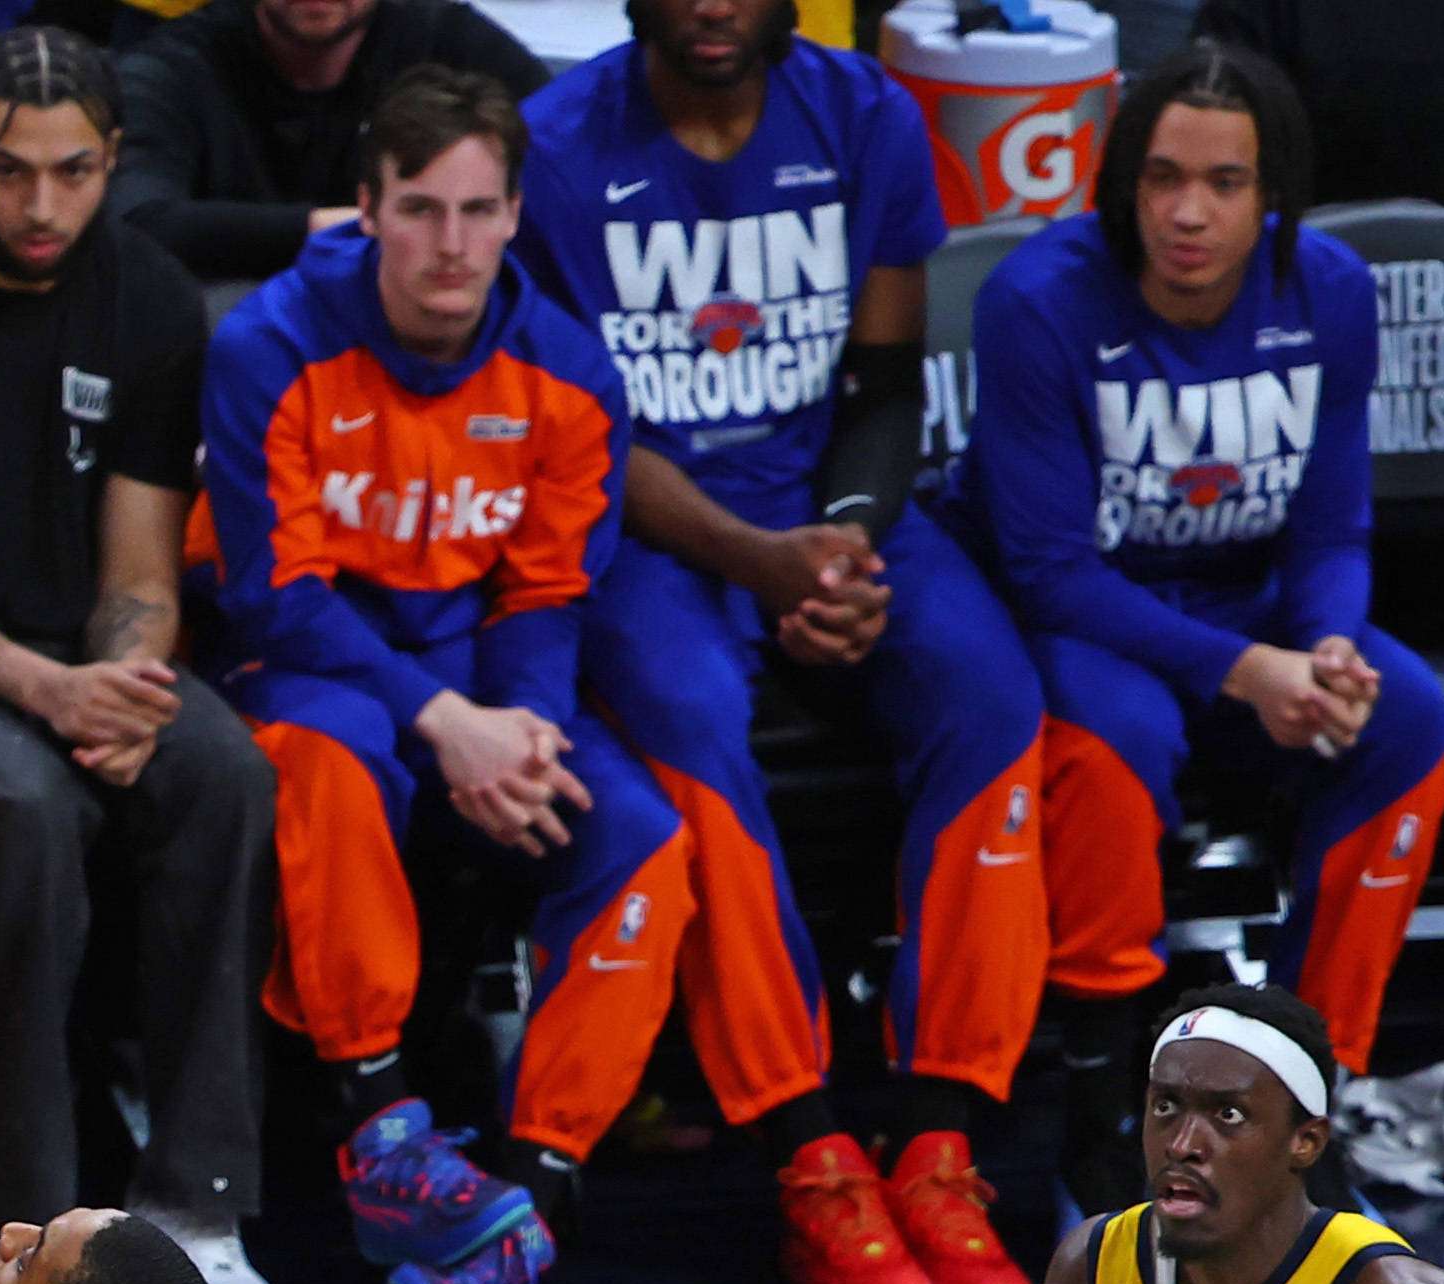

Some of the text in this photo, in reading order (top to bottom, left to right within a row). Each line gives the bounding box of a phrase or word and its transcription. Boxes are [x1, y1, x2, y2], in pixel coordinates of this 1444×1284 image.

[999, 110, 1076, 201] G
[604, 203, 848, 312] WIN
[600, 293, 851, 351] FOR THE
[1096, 364, 1322, 466] WIN
